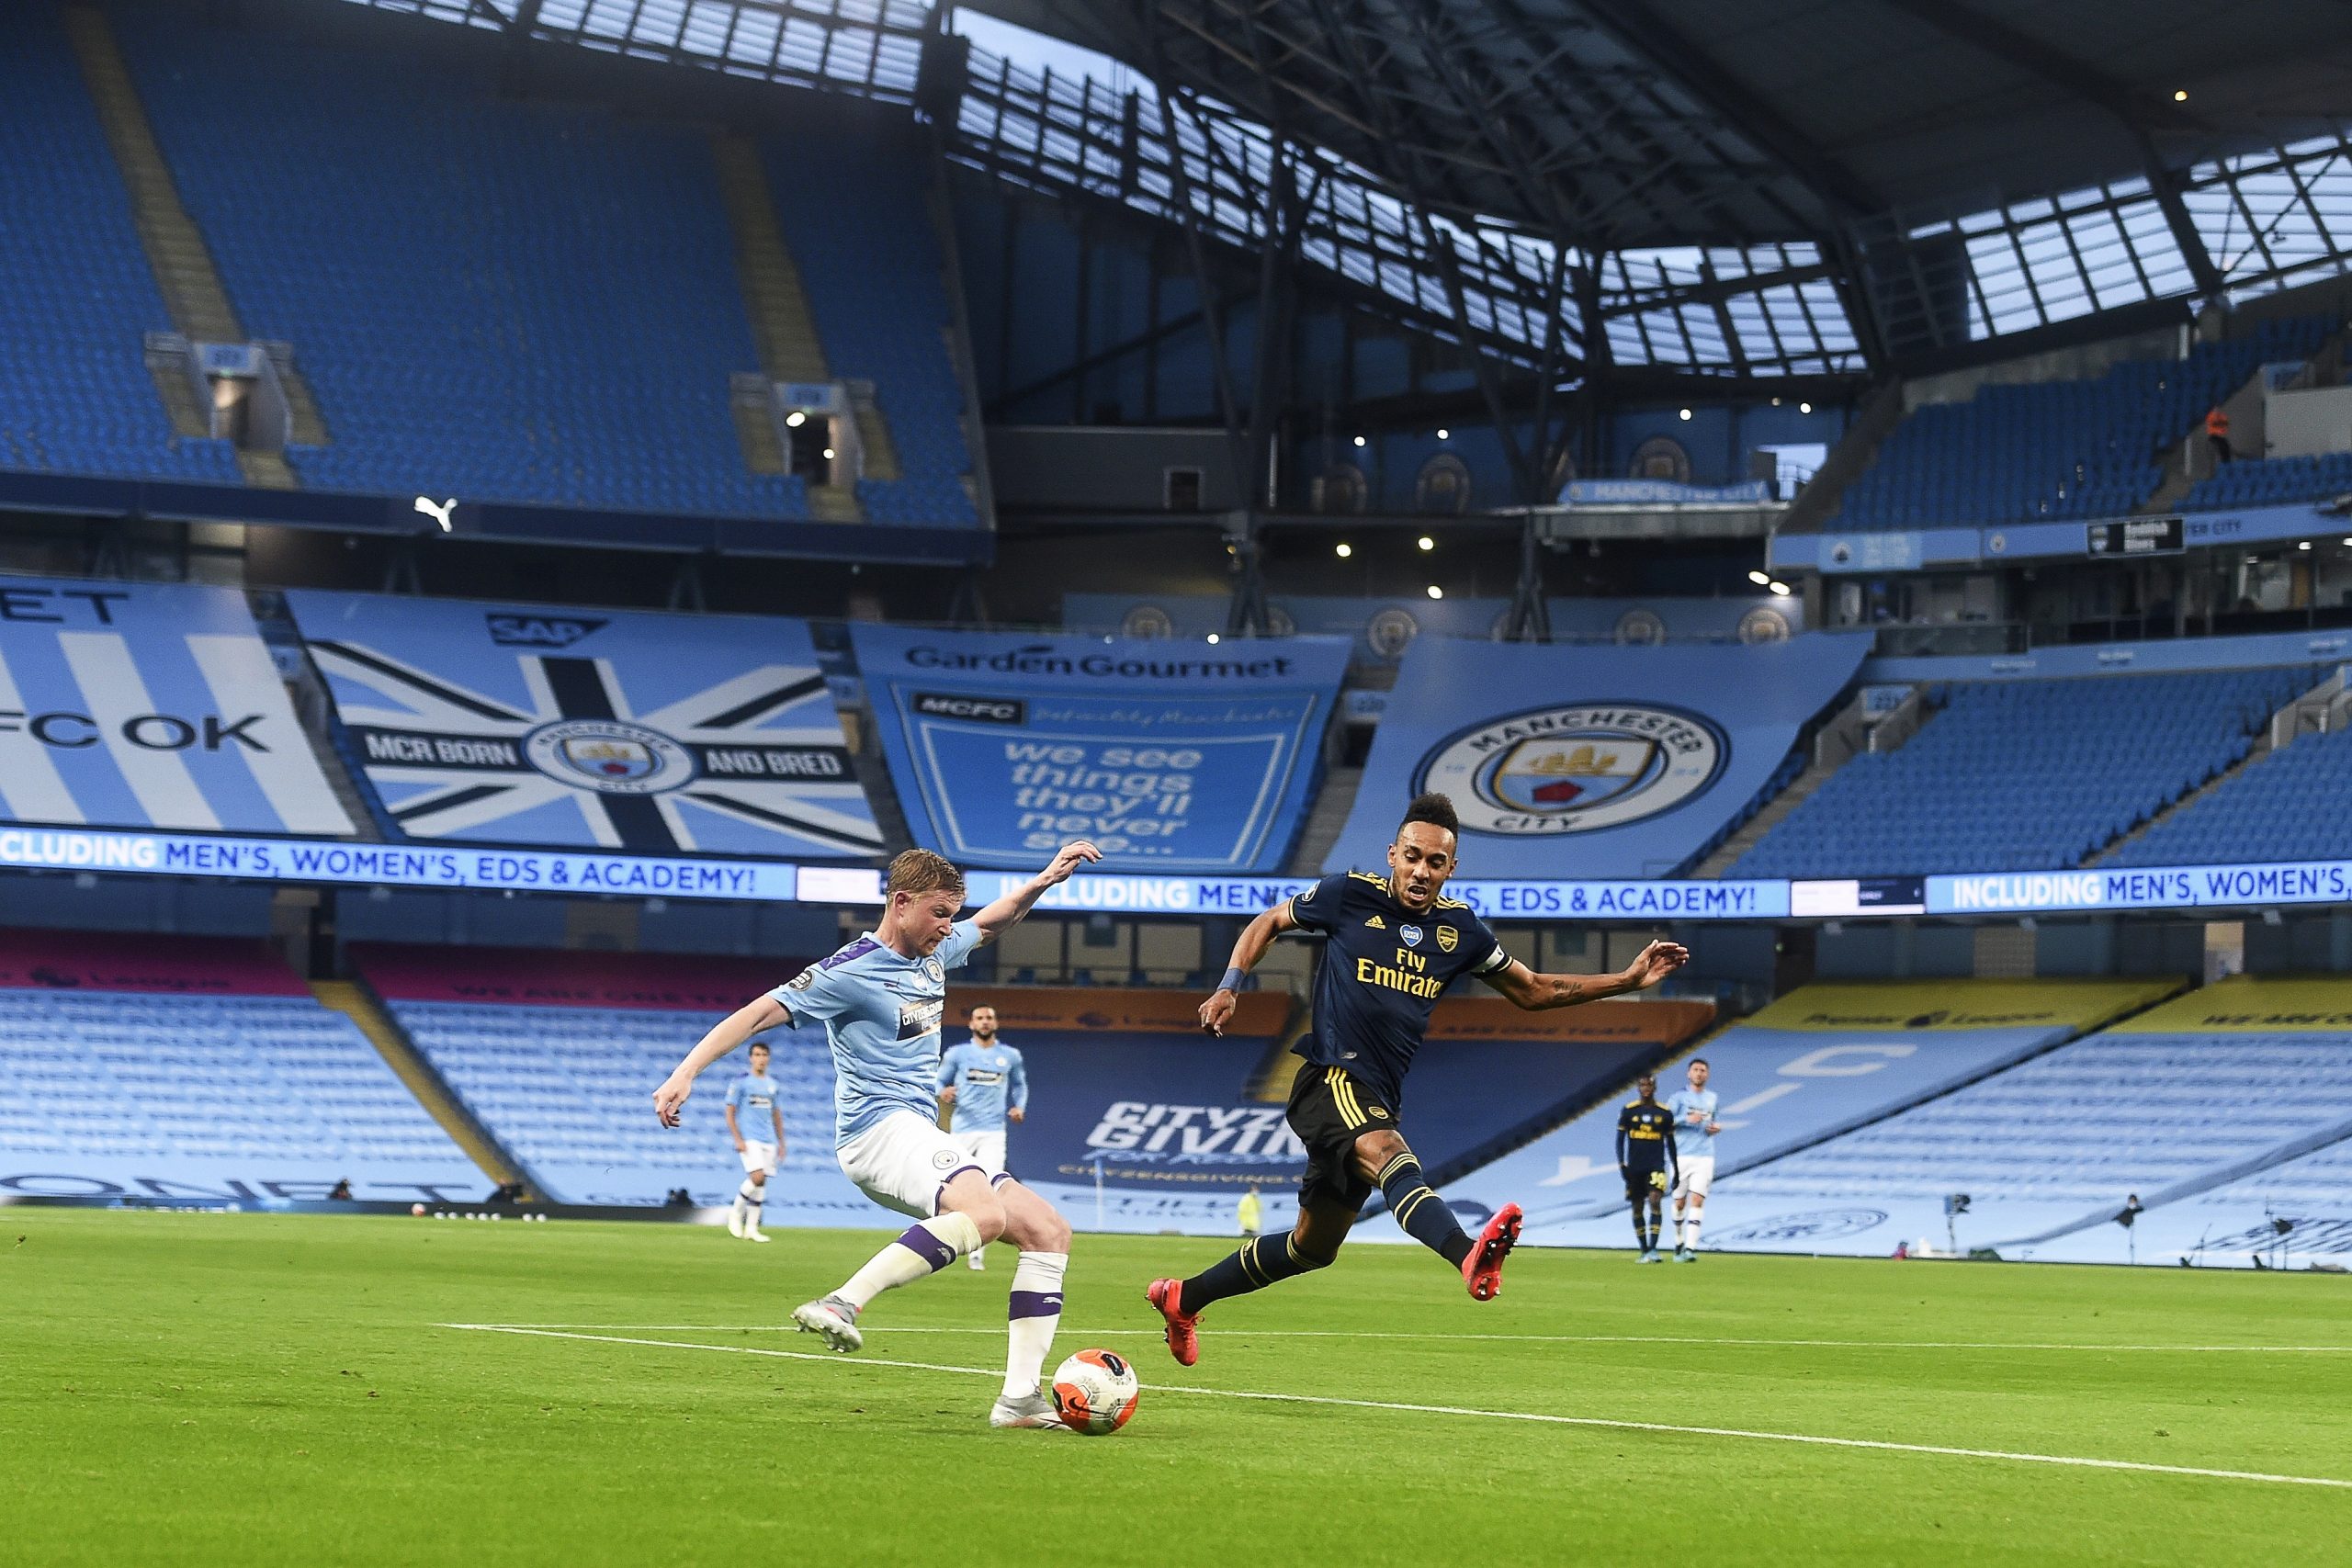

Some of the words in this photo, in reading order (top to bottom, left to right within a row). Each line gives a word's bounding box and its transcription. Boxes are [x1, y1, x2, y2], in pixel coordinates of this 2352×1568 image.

[490, 616, 584, 644] SAP
[904, 647, 1073, 677] Garden
[1079, 653, 1295, 680] Gourmet
[921, 697, 1016, 720] MCFC
[121, 714, 270, 753] OK
[1470, 710, 1704, 756] MANCHESTER
[365, 734, 435, 762] MCR
[435, 739, 518, 766] BORN
[706, 749, 764, 774] AND
[766, 751, 842, 776] BRED
[1005, 742, 1086, 764] we
[1100, 747, 1203, 770] see
[1012, 763, 1192, 797] things
[1015, 787, 1192, 819] they'll
[1018, 812, 1188, 837] never
[1492, 815, 1583, 830] CITY
[0, 831, 157, 868] CLUDING
[165, 842, 279, 877] MEN'S,
[291, 850, 466, 886] WOMEN'S,
[478, 857, 539, 883] EDS
[551, 861, 570, 884] &
[580, 862, 756, 892] ACADEMY!
[1500, 886, 1560, 911] EDS
[1571, 887, 1588, 911] &
[1597, 886, 1757, 912] ACADEMY!
[1953, 873, 2101, 908] INCLUDING
[2108, 873, 2198, 905] MEN'S,
[2207, 867, 2352, 900] WOMEN'S,
[1396, 947, 1427, 973] Fly
[1103, 1101, 1286, 1132] CITYZ
[1086, 1122, 1309, 1156] GIVIN
